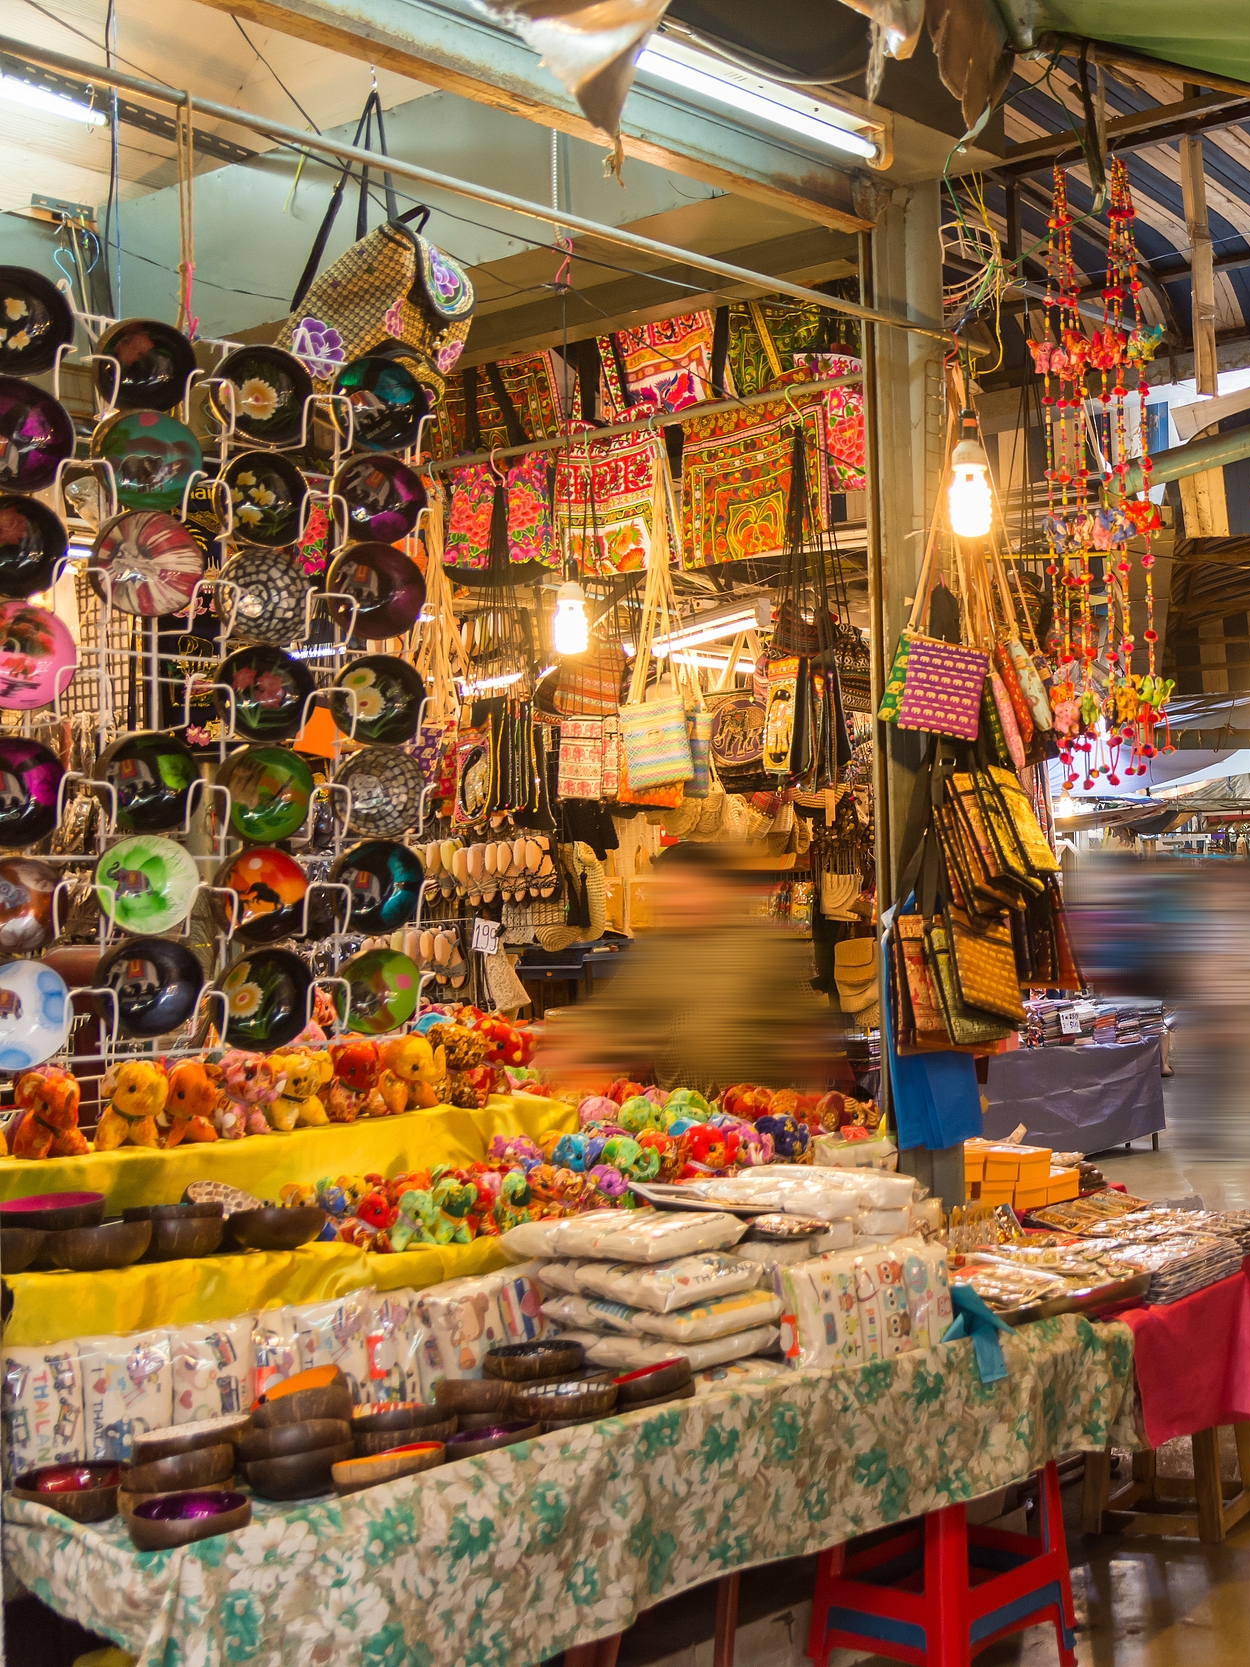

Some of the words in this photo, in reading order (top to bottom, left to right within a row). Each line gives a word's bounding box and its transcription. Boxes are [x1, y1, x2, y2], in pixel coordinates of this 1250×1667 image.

[692, 1261, 753, 1285] THLAND
[32, 1369, 51, 1463] THAILAN
[92, 1401, 105, 1460] THAILAN
